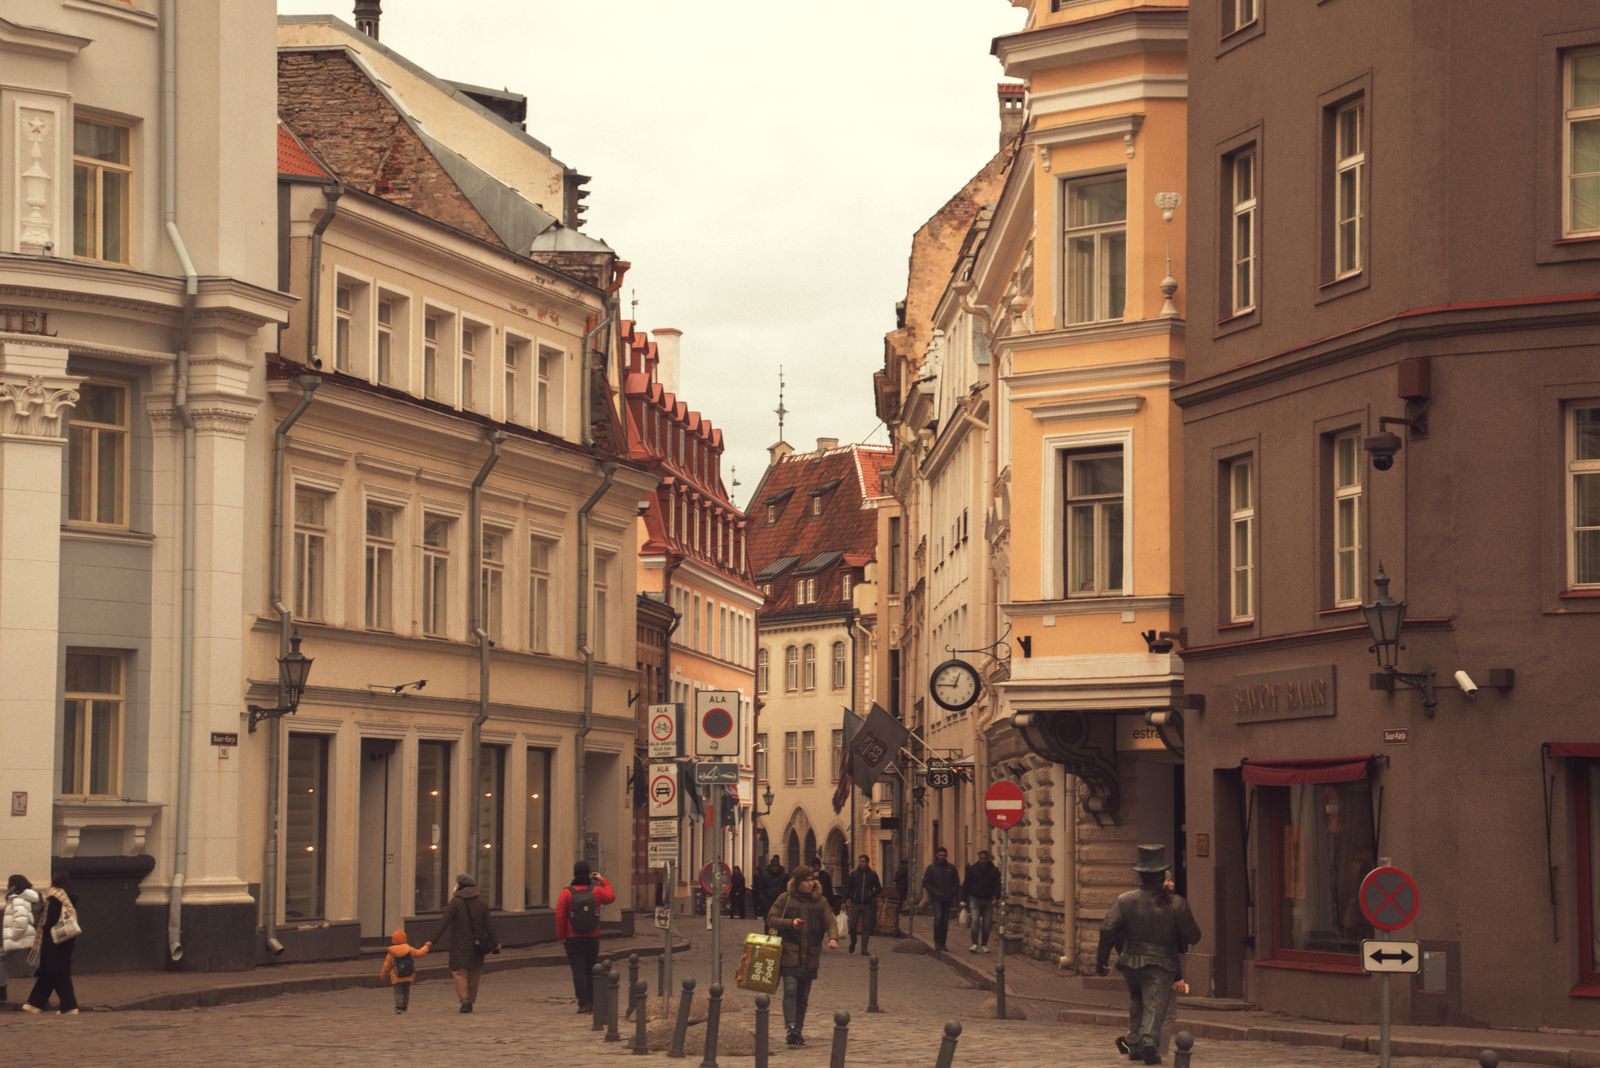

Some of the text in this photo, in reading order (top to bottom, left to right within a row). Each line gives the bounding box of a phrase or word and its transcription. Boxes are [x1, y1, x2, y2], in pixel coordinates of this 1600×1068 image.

[869, 746, 883, 762] 33
[933, 774, 949, 785] 33
[751, 961, 764, 981] Bolt
[762, 958, 775, 984] Food
